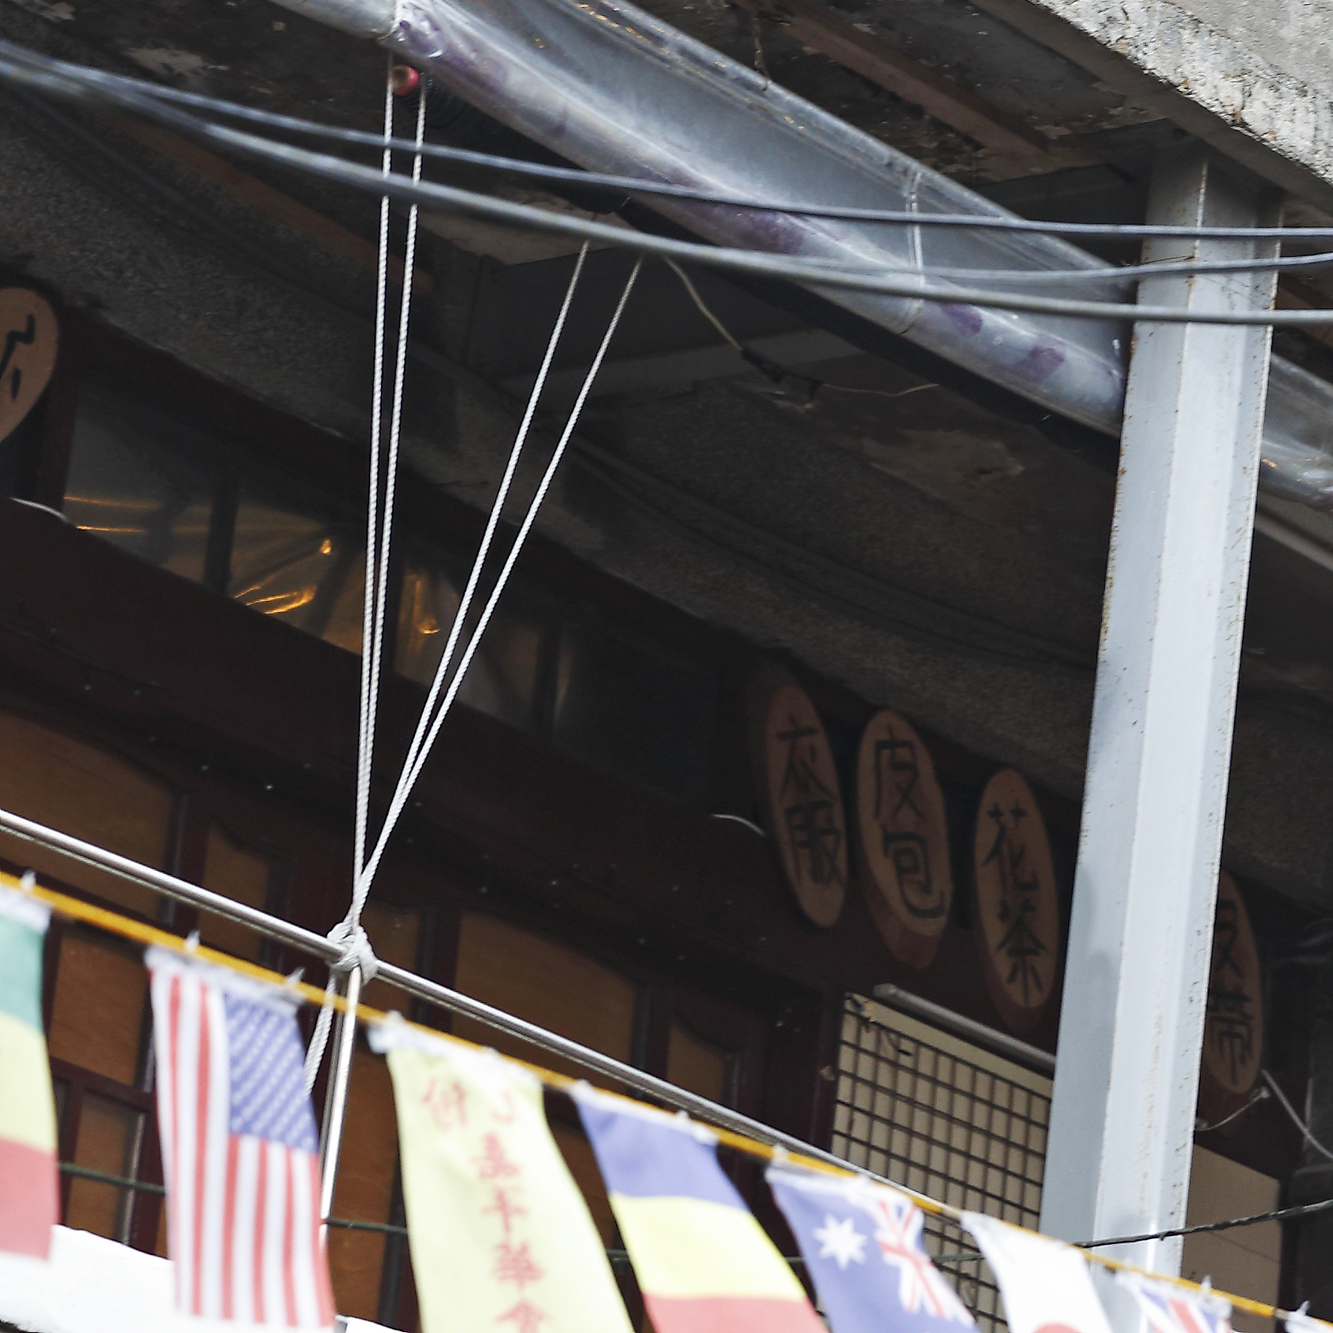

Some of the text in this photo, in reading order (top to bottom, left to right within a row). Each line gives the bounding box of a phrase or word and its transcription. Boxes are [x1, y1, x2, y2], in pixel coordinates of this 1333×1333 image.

[776, 714, 848, 890] 衣服
[872, 722, 947, 919] 皮包
[980, 804, 1050, 1009] 花茶
